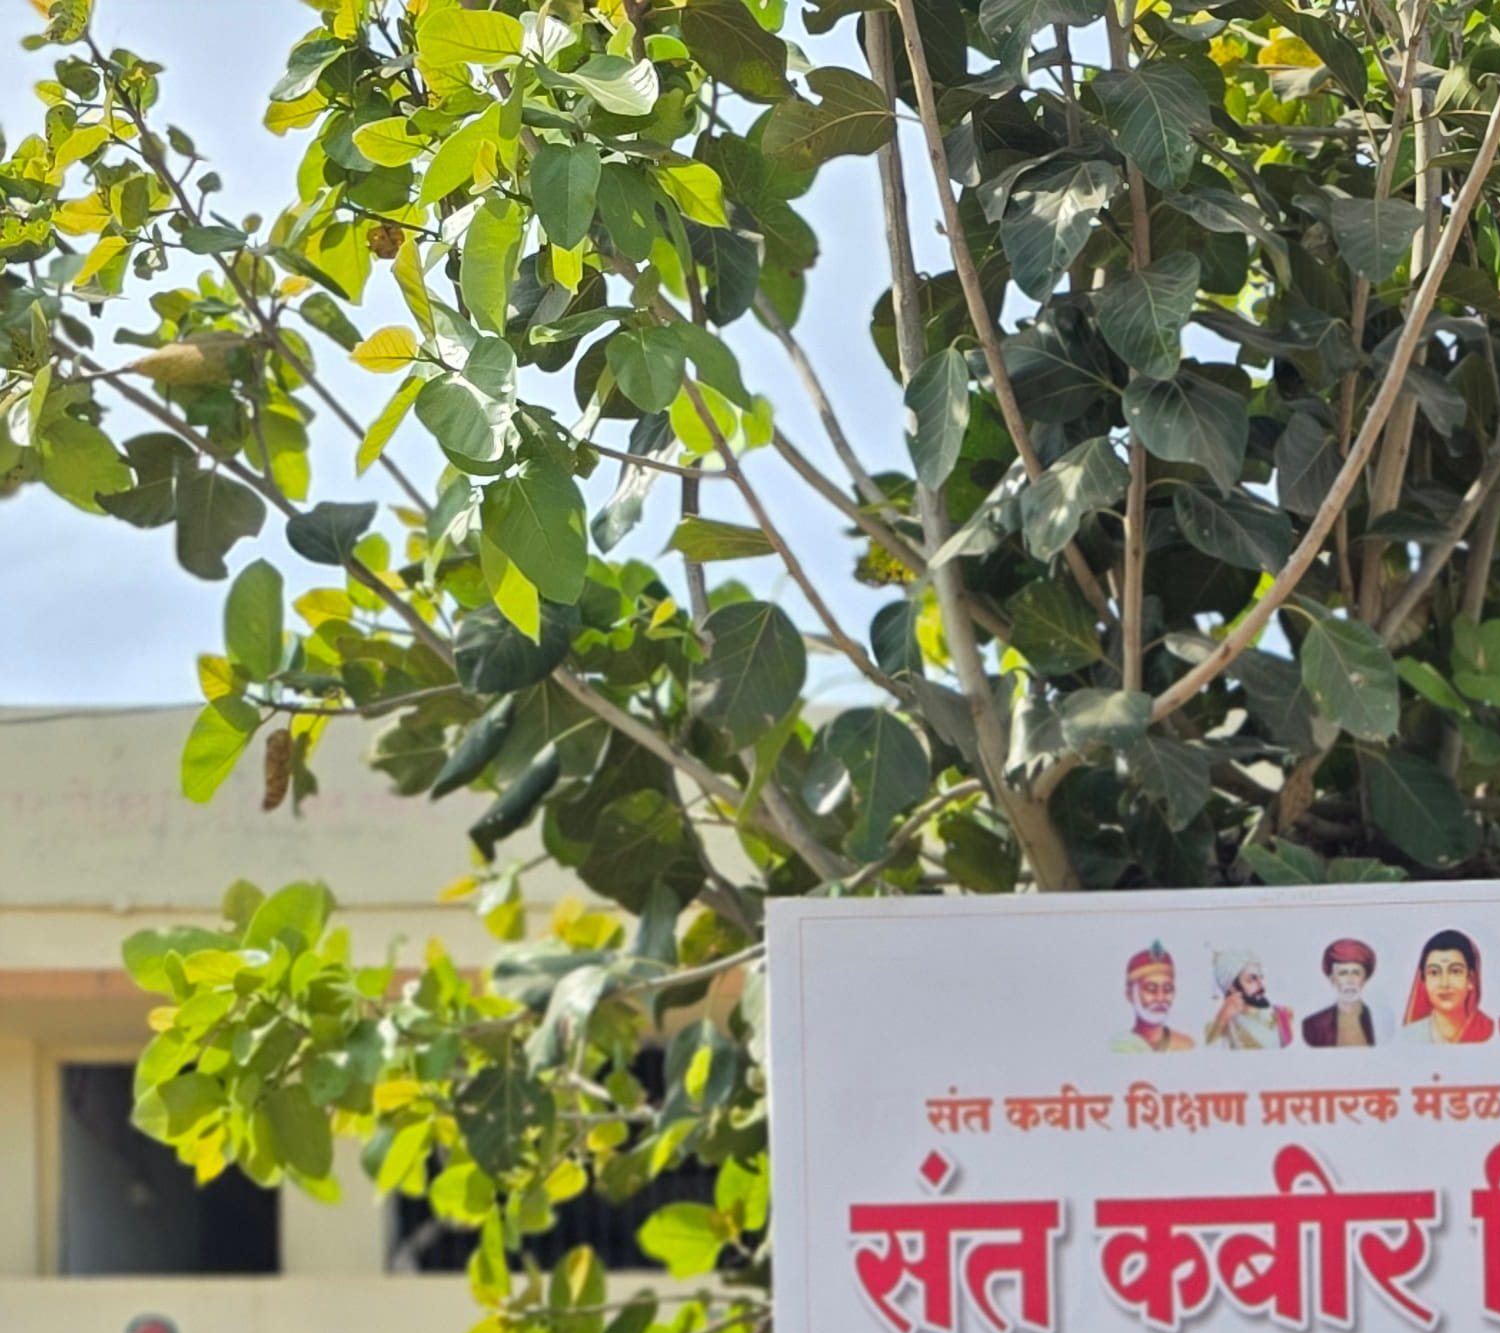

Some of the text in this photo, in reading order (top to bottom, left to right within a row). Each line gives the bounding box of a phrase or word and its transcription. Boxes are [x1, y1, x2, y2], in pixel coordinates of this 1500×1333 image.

[926, 1086, 994, 1134] संत
[1004, 1084, 1113, 1131] कबीर
[1124, 1081, 1248, 1133] शिक्षण
[1259, 1088, 1400, 1126] प्रसारक
[850, 1153, 1060, 1332] संत
[1095, 1144, 1438, 1325] कबीर
